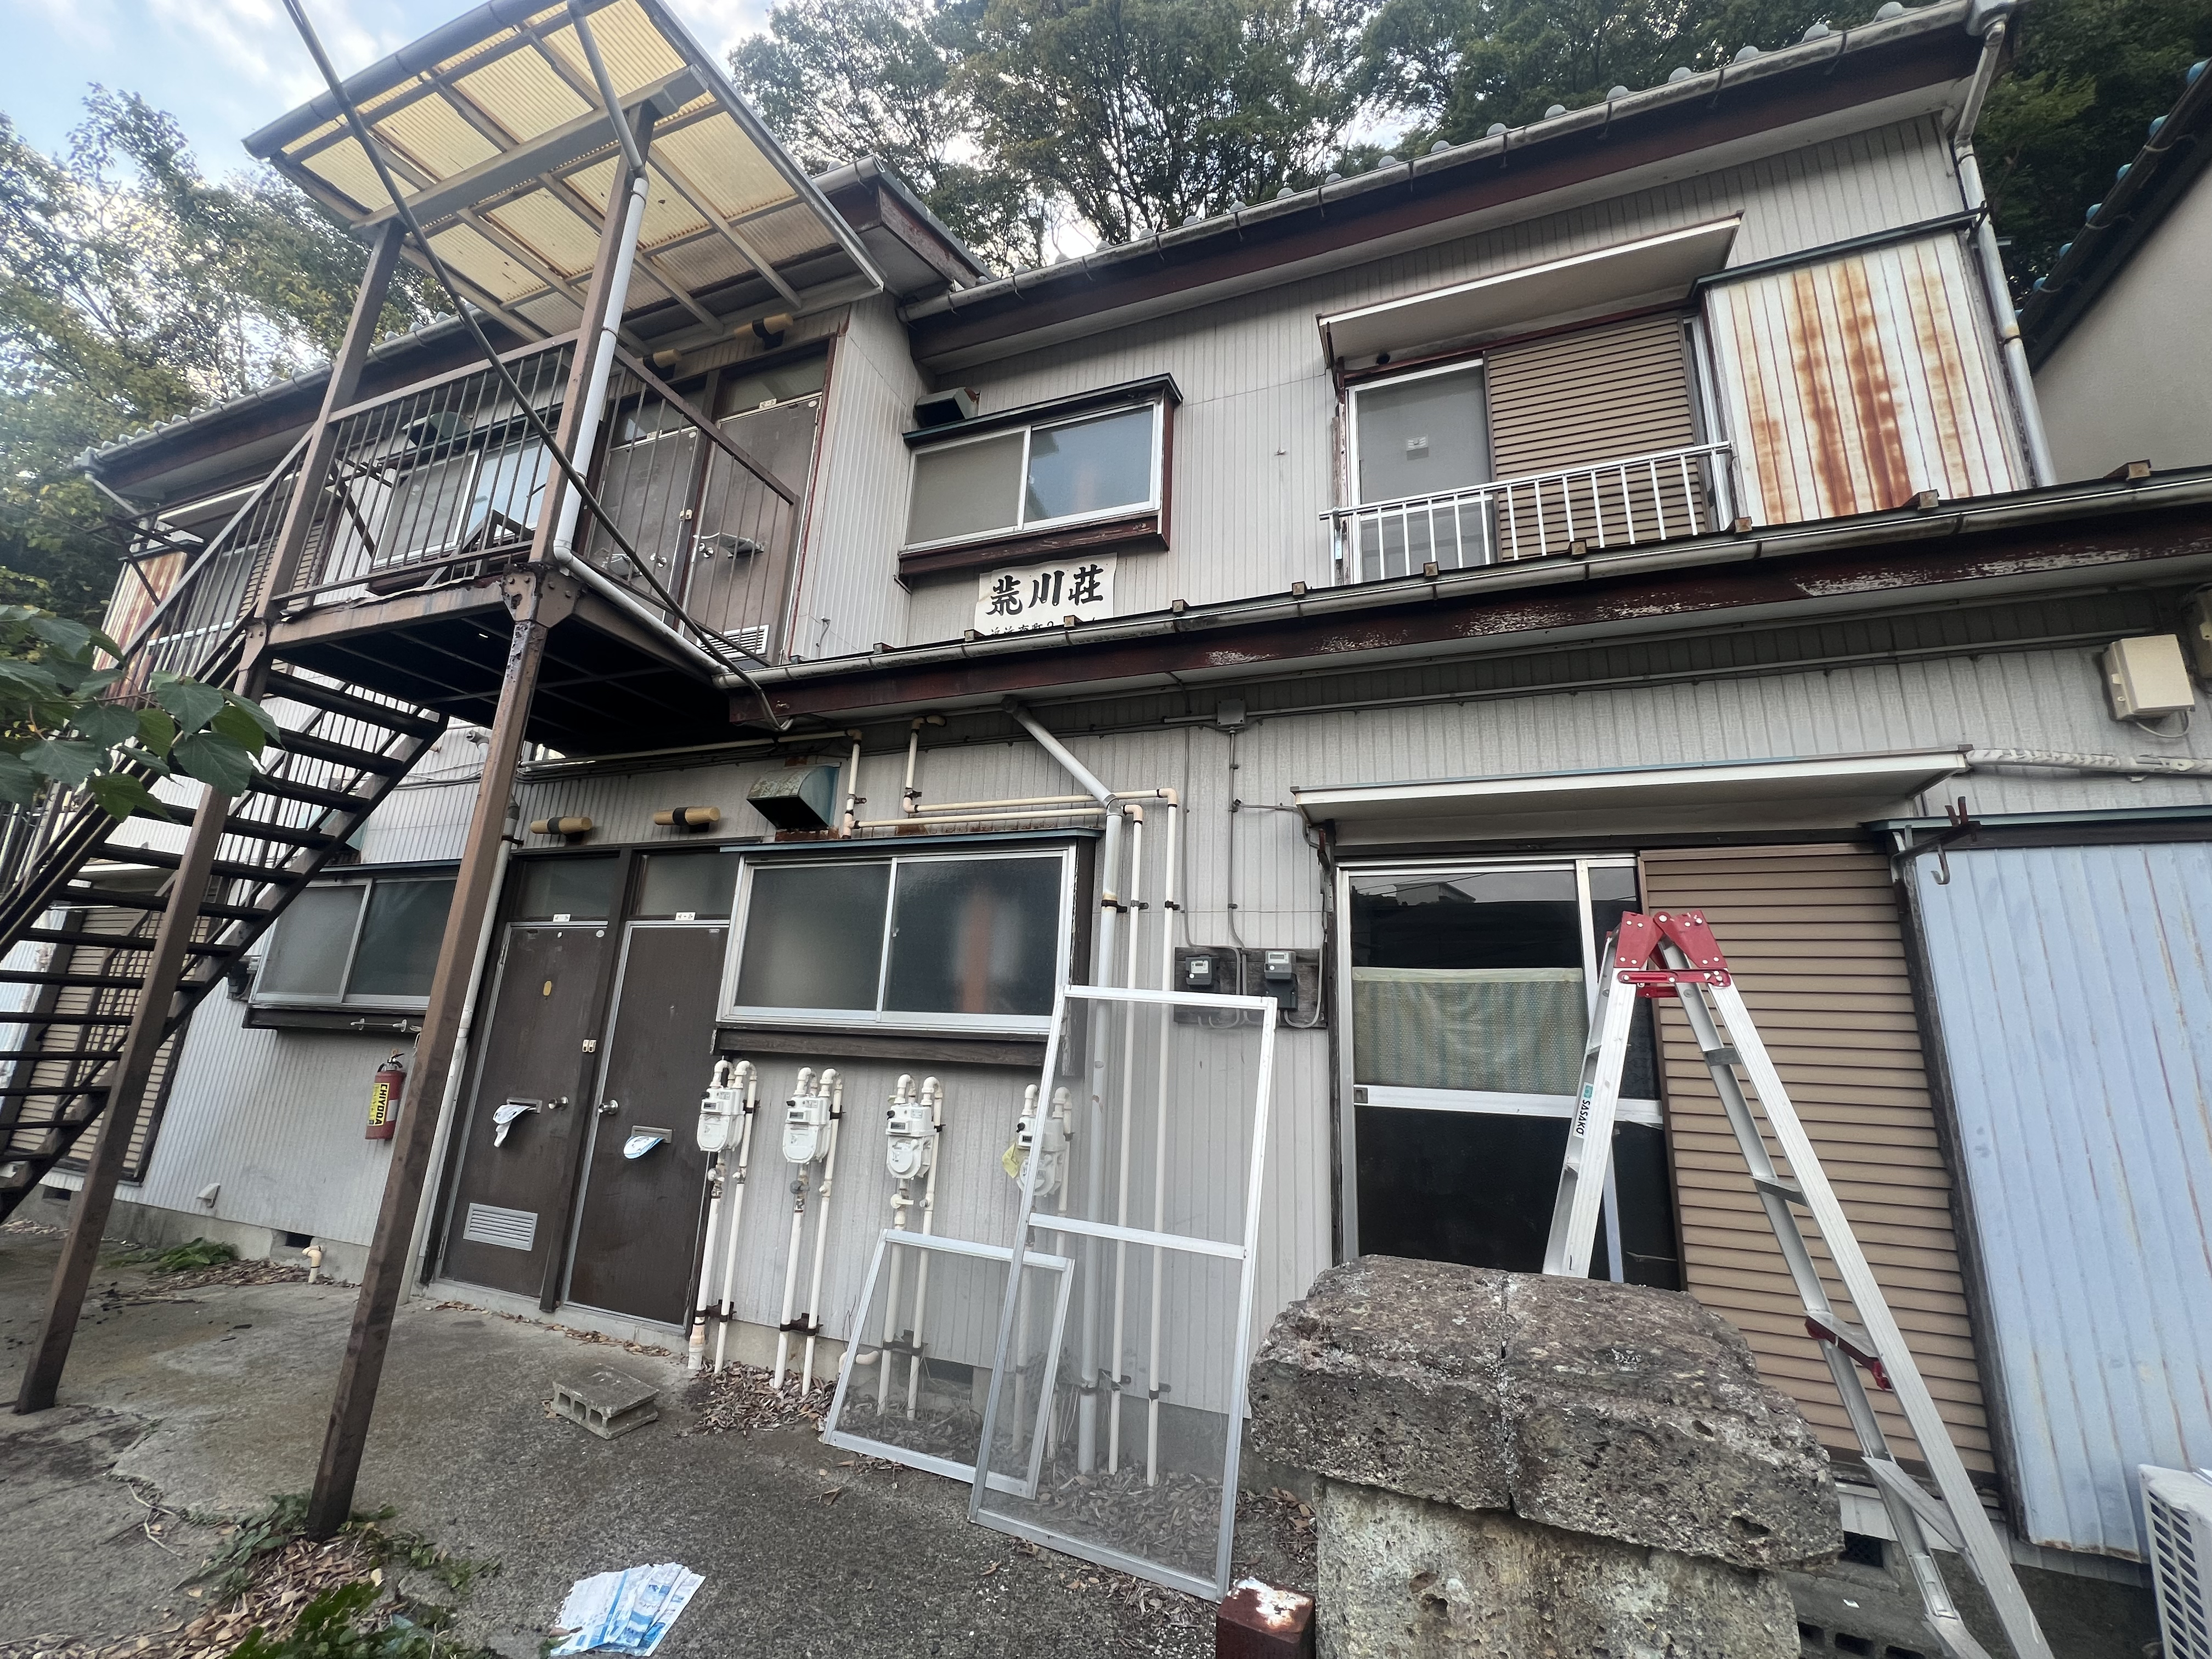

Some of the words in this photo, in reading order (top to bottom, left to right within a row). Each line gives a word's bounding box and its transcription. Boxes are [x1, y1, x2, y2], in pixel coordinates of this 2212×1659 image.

[985, 564, 1104, 616] 荒川荘
[375, 1084, 388, 1125] CHIYODA
[1576, 1099, 1590, 1136] SASAKO
